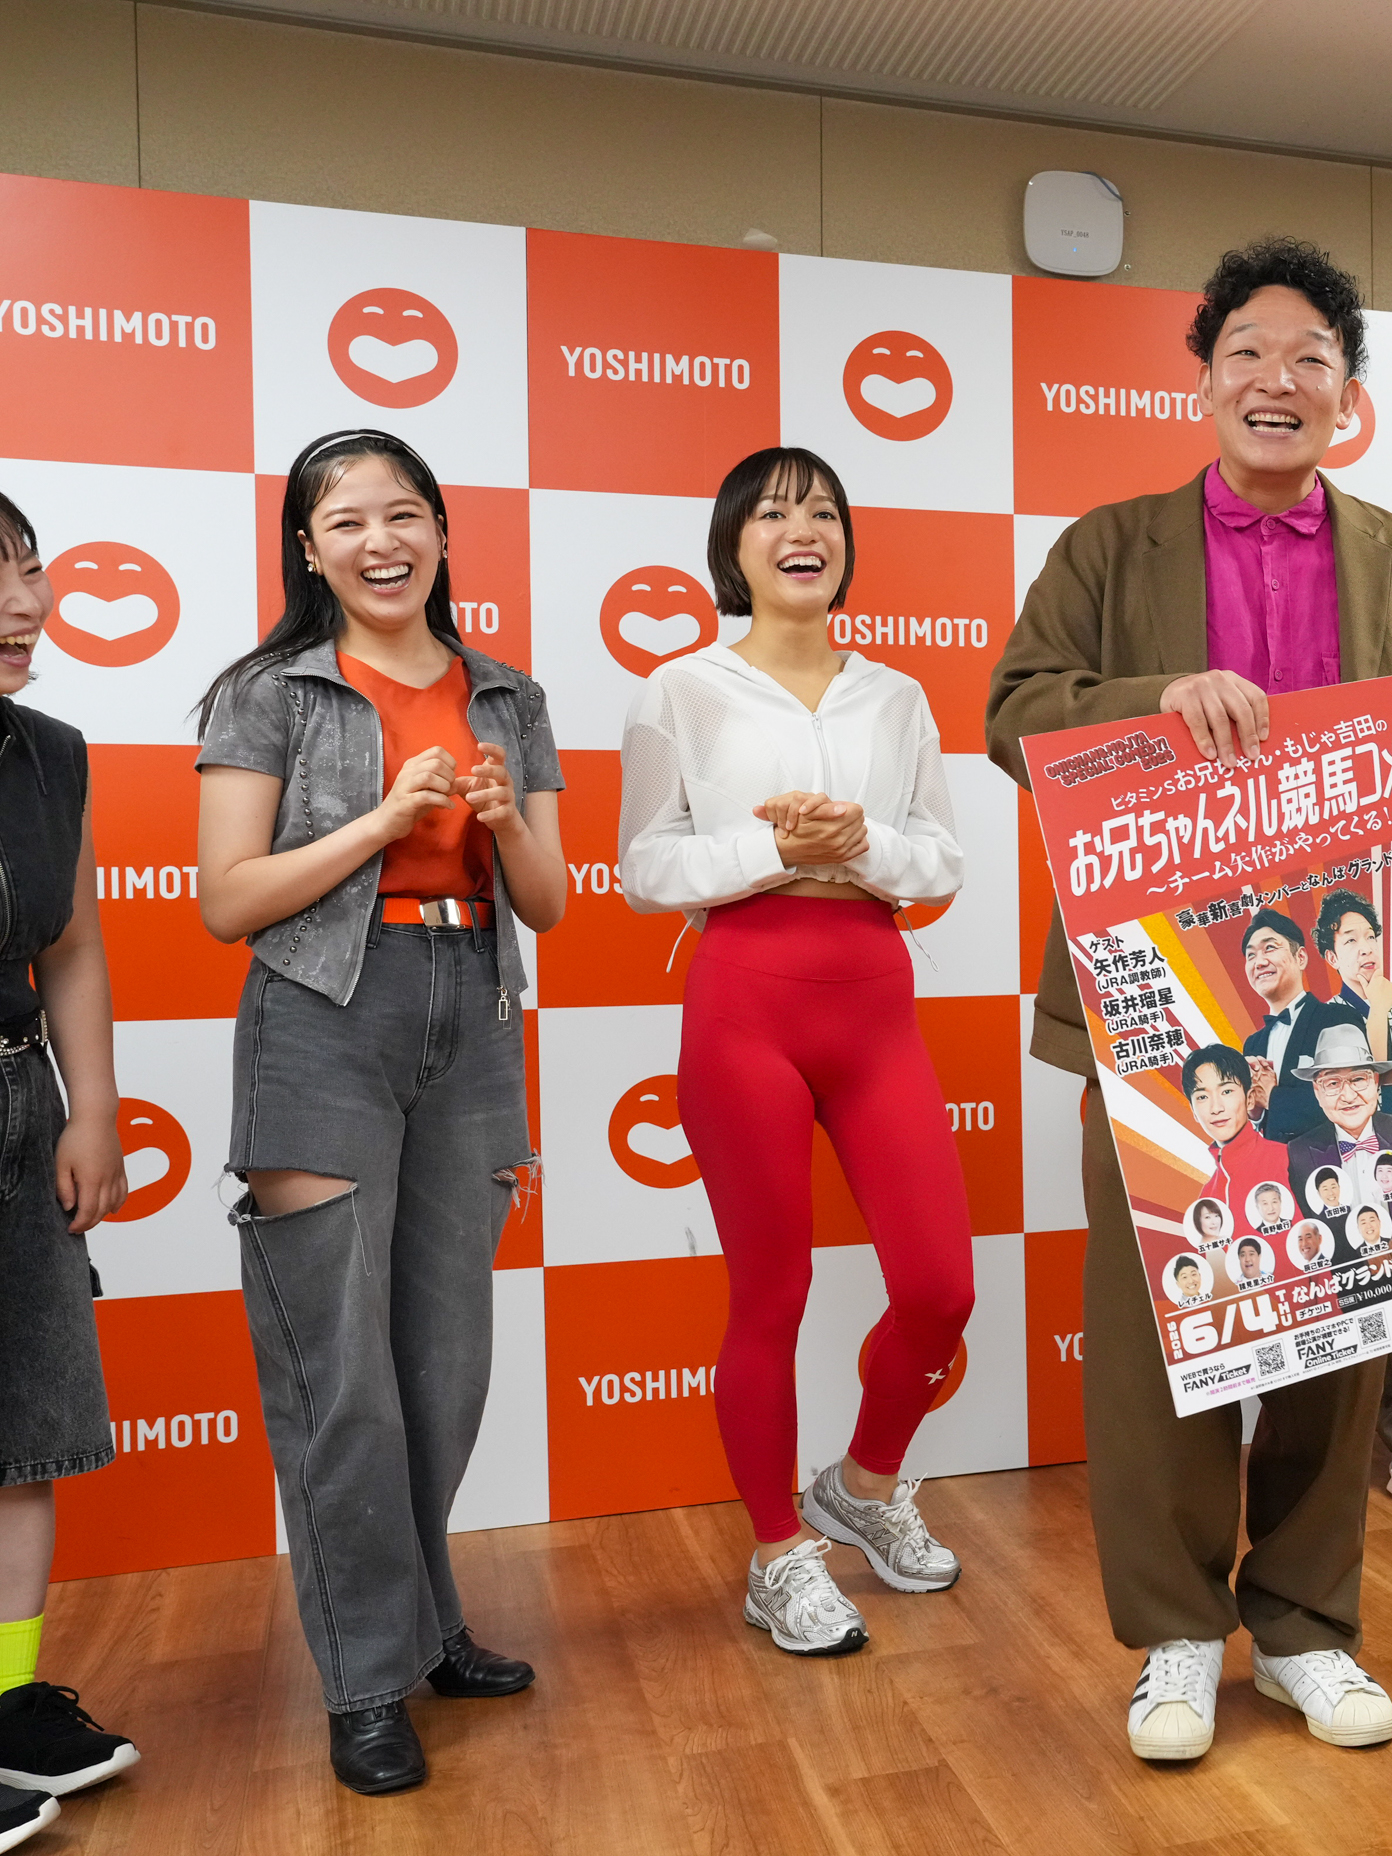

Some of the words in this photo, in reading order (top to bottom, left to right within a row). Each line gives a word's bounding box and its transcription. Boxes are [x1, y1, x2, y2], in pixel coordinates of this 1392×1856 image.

[0, 299, 216, 350] YOSHIMOTO
[561, 345, 750, 390] YOSHIMOTO
[1041, 382, 1203, 422] YOSHIMOTO
[827, 614, 988, 648] OSHIMOTO
[1060, 758, 1116, 787] SPECIAL
[1114, 737, 1169, 767] COMEDY!
[1141, 750, 1176, 771] 2026
[1089, 935, 1124, 953] ゲスト
[1093, 946, 1165, 977] 矢作芳人
[1103, 987, 1175, 1018] 坂井瑠星
[1112, 1029, 1185, 1060] 古川奈穂
[1178, 1292, 1213, 1308] レイチェル
[1275, 1290, 1293, 1327] THU
[1299, 1303, 1330, 1319] チケット
[1179, 1294, 1280, 1355] 6/4
[1167, 1321, 1184, 1360] 2026
[1297, 1338, 1335, 1360] FANY
[1180, 1363, 1226, 1382] WEBで買うなら
[1306, 1353, 1332, 1368] Online
[1332, 1346, 1356, 1360] Ticket
[578, 1366, 716, 1406] YOSHIM
[1183, 1375, 1218, 1393] FANY
[1221, 1367, 1248, 1381] Ticket
